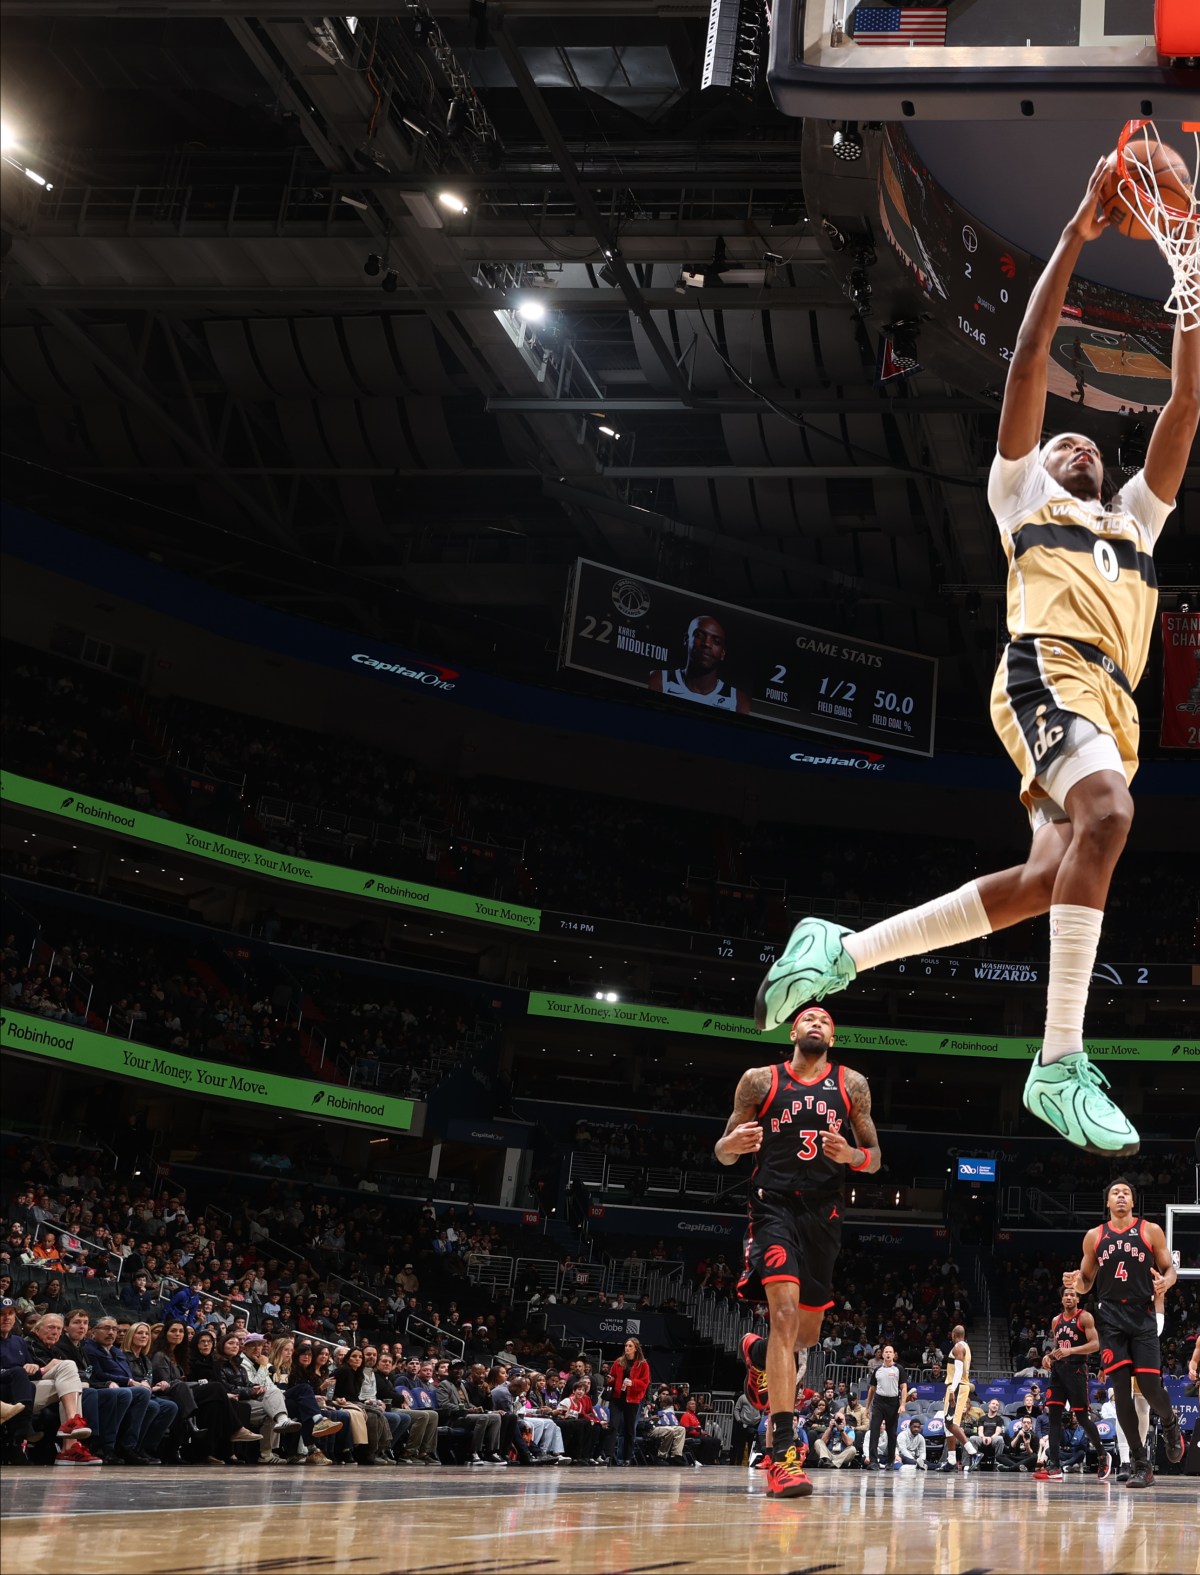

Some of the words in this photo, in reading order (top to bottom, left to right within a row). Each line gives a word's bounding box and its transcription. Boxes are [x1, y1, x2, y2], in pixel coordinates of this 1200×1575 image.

[964, 263, 972, 279] 2
[1000, 289, 1008, 303] 0
[957, 316, 986, 346] 10:46
[1093, 539, 1120, 583] 0
[579, 615, 613, 644] 22
[616, 635, 668, 662] MIDDLETON
[796, 637, 838, 657] GAME
[840, 648, 883, 668] STATS
[770, 664, 787, 684] 2
[766, 688, 788, 703] POINTS
[818, 677, 857, 701] 1/2
[818, 701, 833, 714] FIELD
[834, 704, 853, 719] GOALS
[873, 690, 914, 715] 50.0
[872, 713, 887, 726] FIELD
[888, 717, 902, 730] GOAL
[75, 801, 136, 828] Robinhood
[185, 833, 211, 851] Your
[212, 842, 250, 864] Money.
[253, 853, 279, 871] Your
[280, 860, 313, 879] Move.
[376, 882, 430, 902] Robinhood
[474, 902, 499, 917] Your
[500, 908, 536, 927] Money.
[560, 920, 578, 931] 7:14
[580, 923, 594, 933] PM
[717, 947, 734, 957] 1/2
[925, 966, 932, 975] 0
[950, 969, 957, 977] 7
[974, 968, 1038, 982] WIZARDS
[981, 962, 1031, 971] WASHINGTON
[1137, 968, 1149, 984] 2
[547, 1000, 572, 1013] Your
[573, 1004, 611, 1020] Money.
[613, 1009, 638, 1020] Your
[639, 1011, 670, 1024] Move.
[7, 1022, 74, 1051] Robinhood
[853, 1034, 876, 1045] Your
[878, 1035, 908, 1047] Move.
[951, 1040, 998, 1052] Robinhood
[1111, 1045, 1140, 1055] Move.
[122, 1050, 150, 1072] Your
[151, 1058, 193, 1083] Money.
[197, 1068, 227, 1089] Your
[228, 1075, 268, 1096] Move.
[326, 1094, 384, 1117] Robinhood
[771, 1096, 843, 1133] RAPTORS
[796, 1130, 818, 1160] 3
[1115, 1261, 1128, 1281] 4
[599, 1322, 623, 1332] Globe
